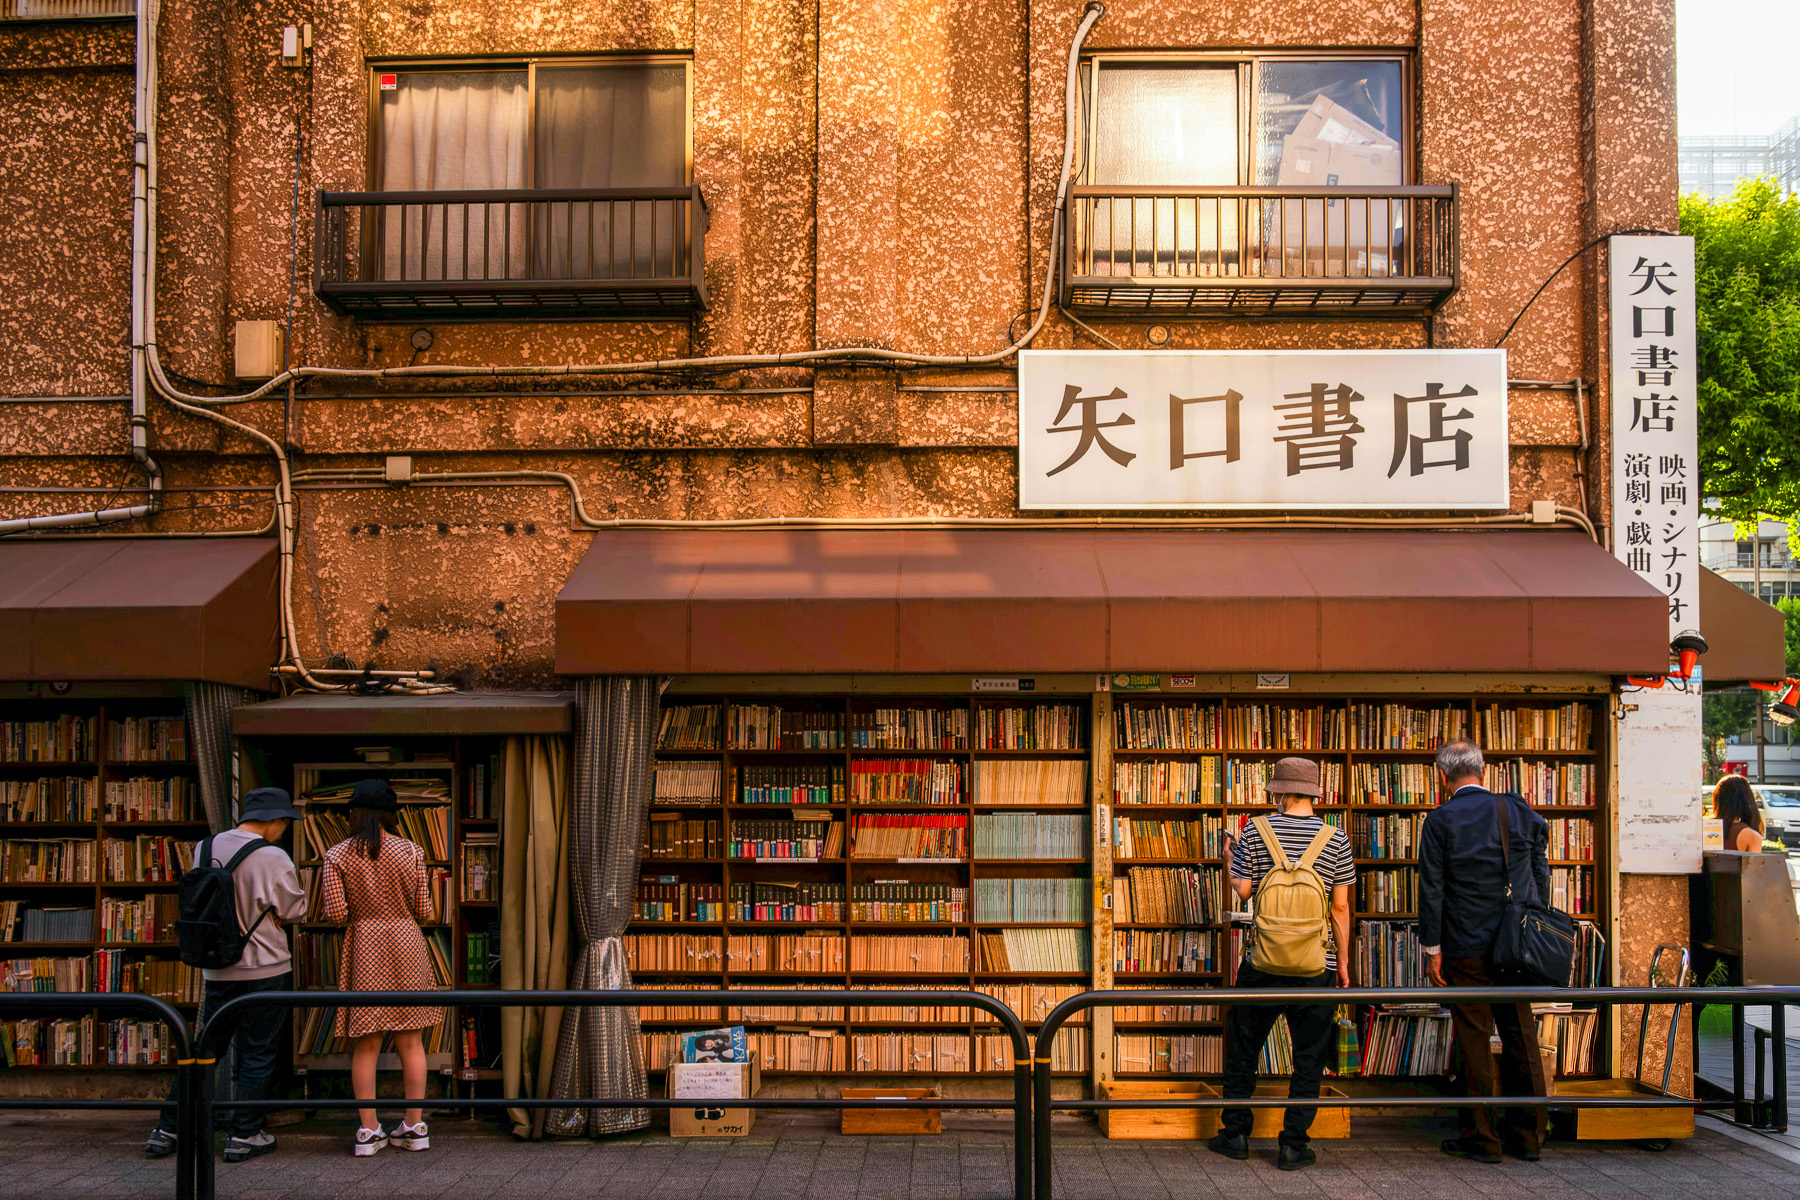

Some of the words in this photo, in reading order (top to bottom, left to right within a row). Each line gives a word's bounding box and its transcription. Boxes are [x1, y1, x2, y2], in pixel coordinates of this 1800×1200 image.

[1628, 256, 1679, 433] 矢口書店
[1046, 382, 1478, 479] 矢口書店
[1624, 453, 1652, 573] 演劇・戯曲
[1659, 453, 1688, 623] 映画・シナリオ
